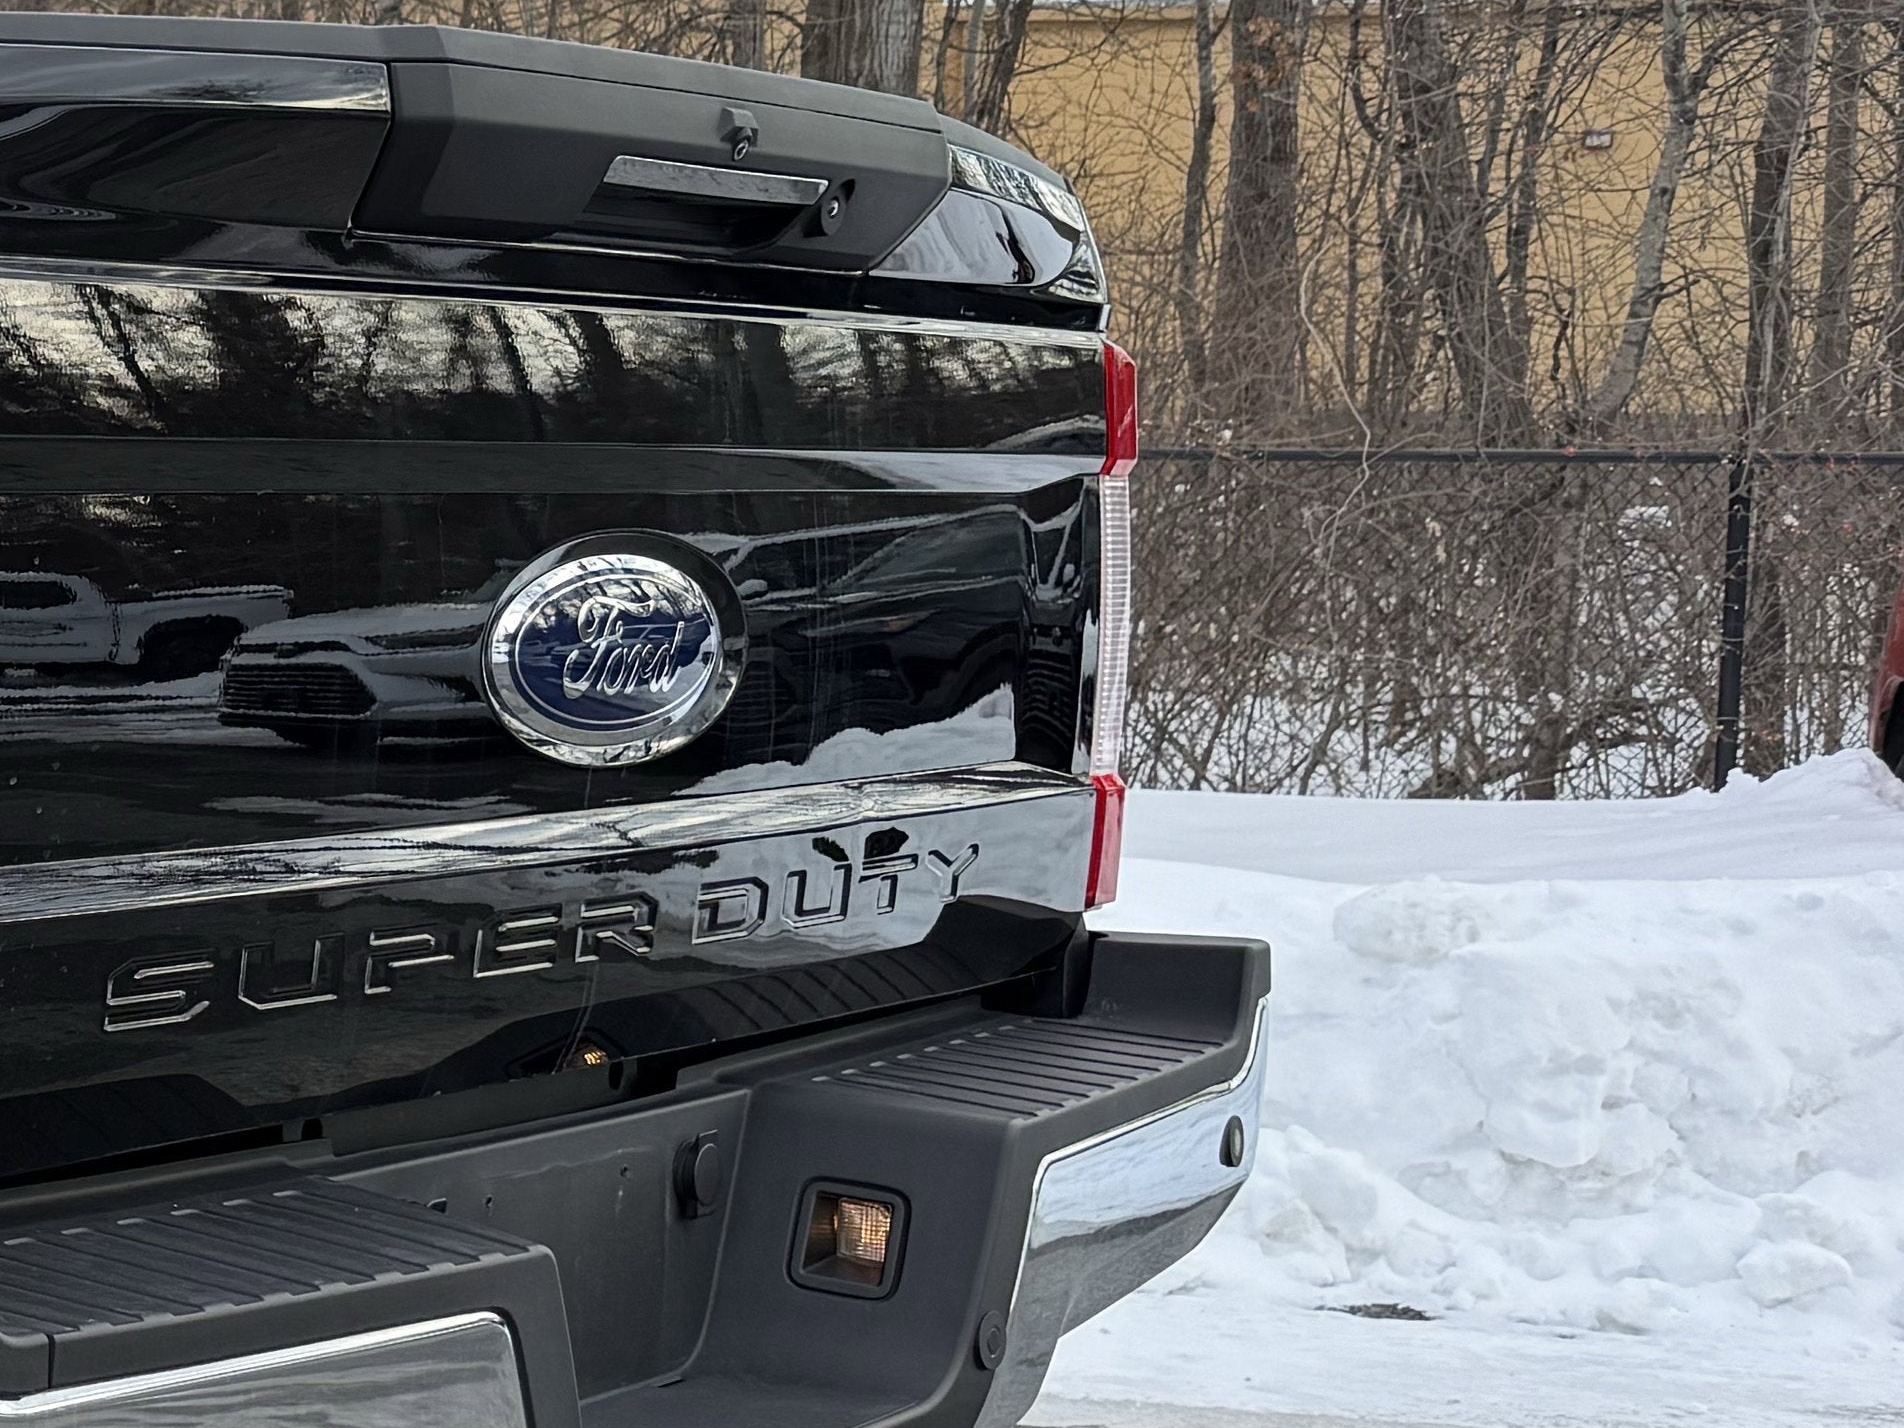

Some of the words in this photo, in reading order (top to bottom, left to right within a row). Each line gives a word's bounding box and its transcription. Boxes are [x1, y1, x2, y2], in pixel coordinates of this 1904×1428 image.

[563, 595, 685, 699] Ford
[102, 892, 658, 1033] SUPER
[691, 842, 980, 945] DUTY
